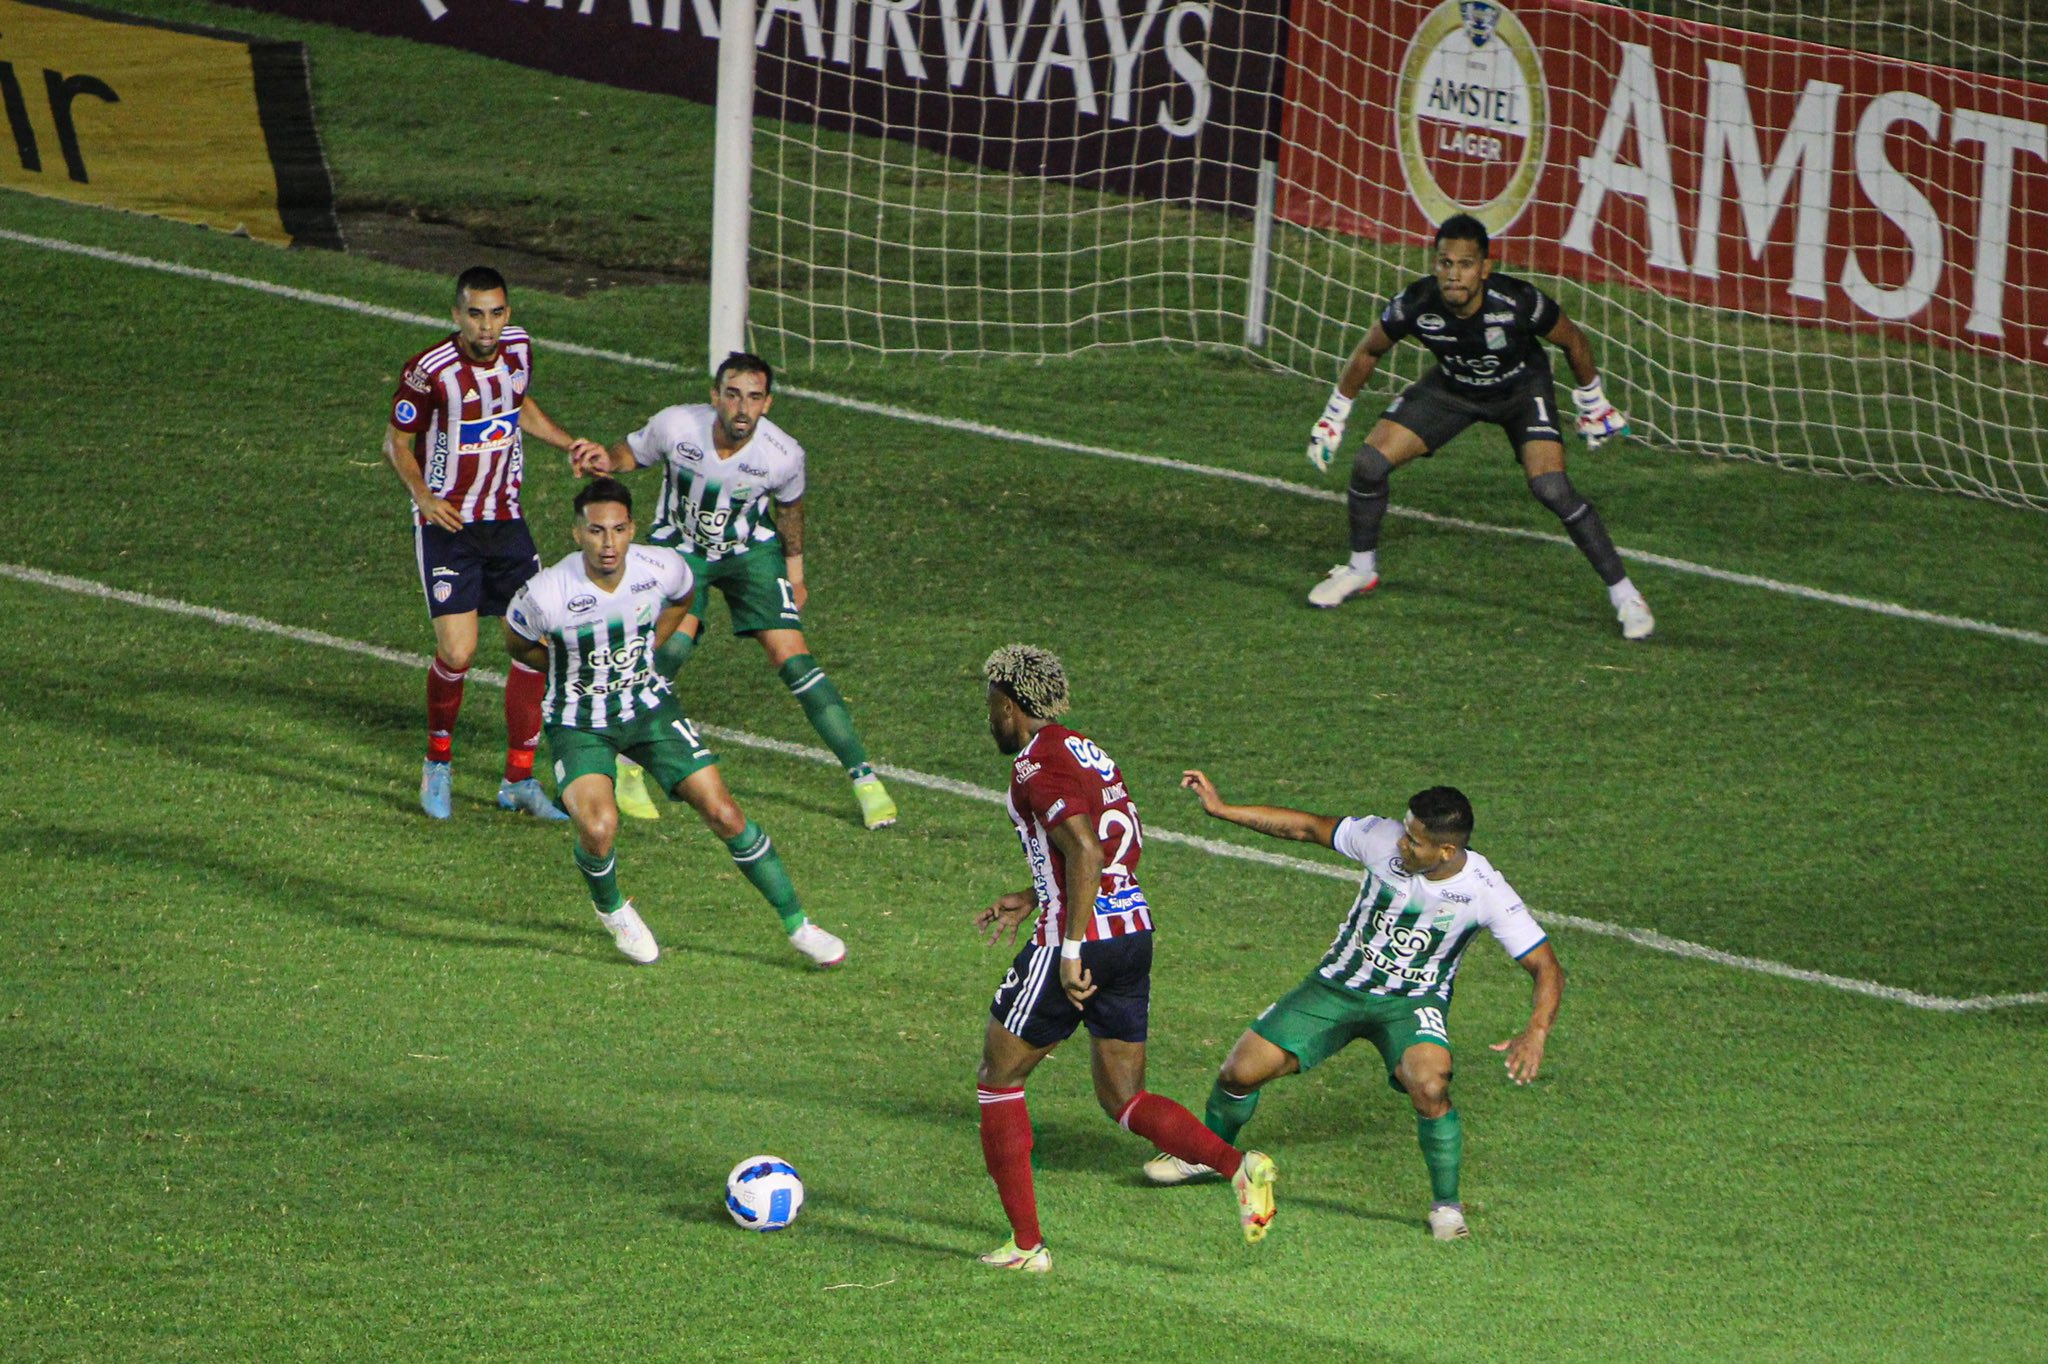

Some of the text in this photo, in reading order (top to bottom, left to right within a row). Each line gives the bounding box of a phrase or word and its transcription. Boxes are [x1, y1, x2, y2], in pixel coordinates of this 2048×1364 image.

[1427, 77, 1519, 125] AMSTEL
[1440, 127, 1503, 161] LAGER
[1561, 42, 2048, 341] AMST
[1533, 396, 1549, 422] 1
[1374, 913, 1430, 958] tigo
[1363, 946, 1436, 983] SUZUKI
